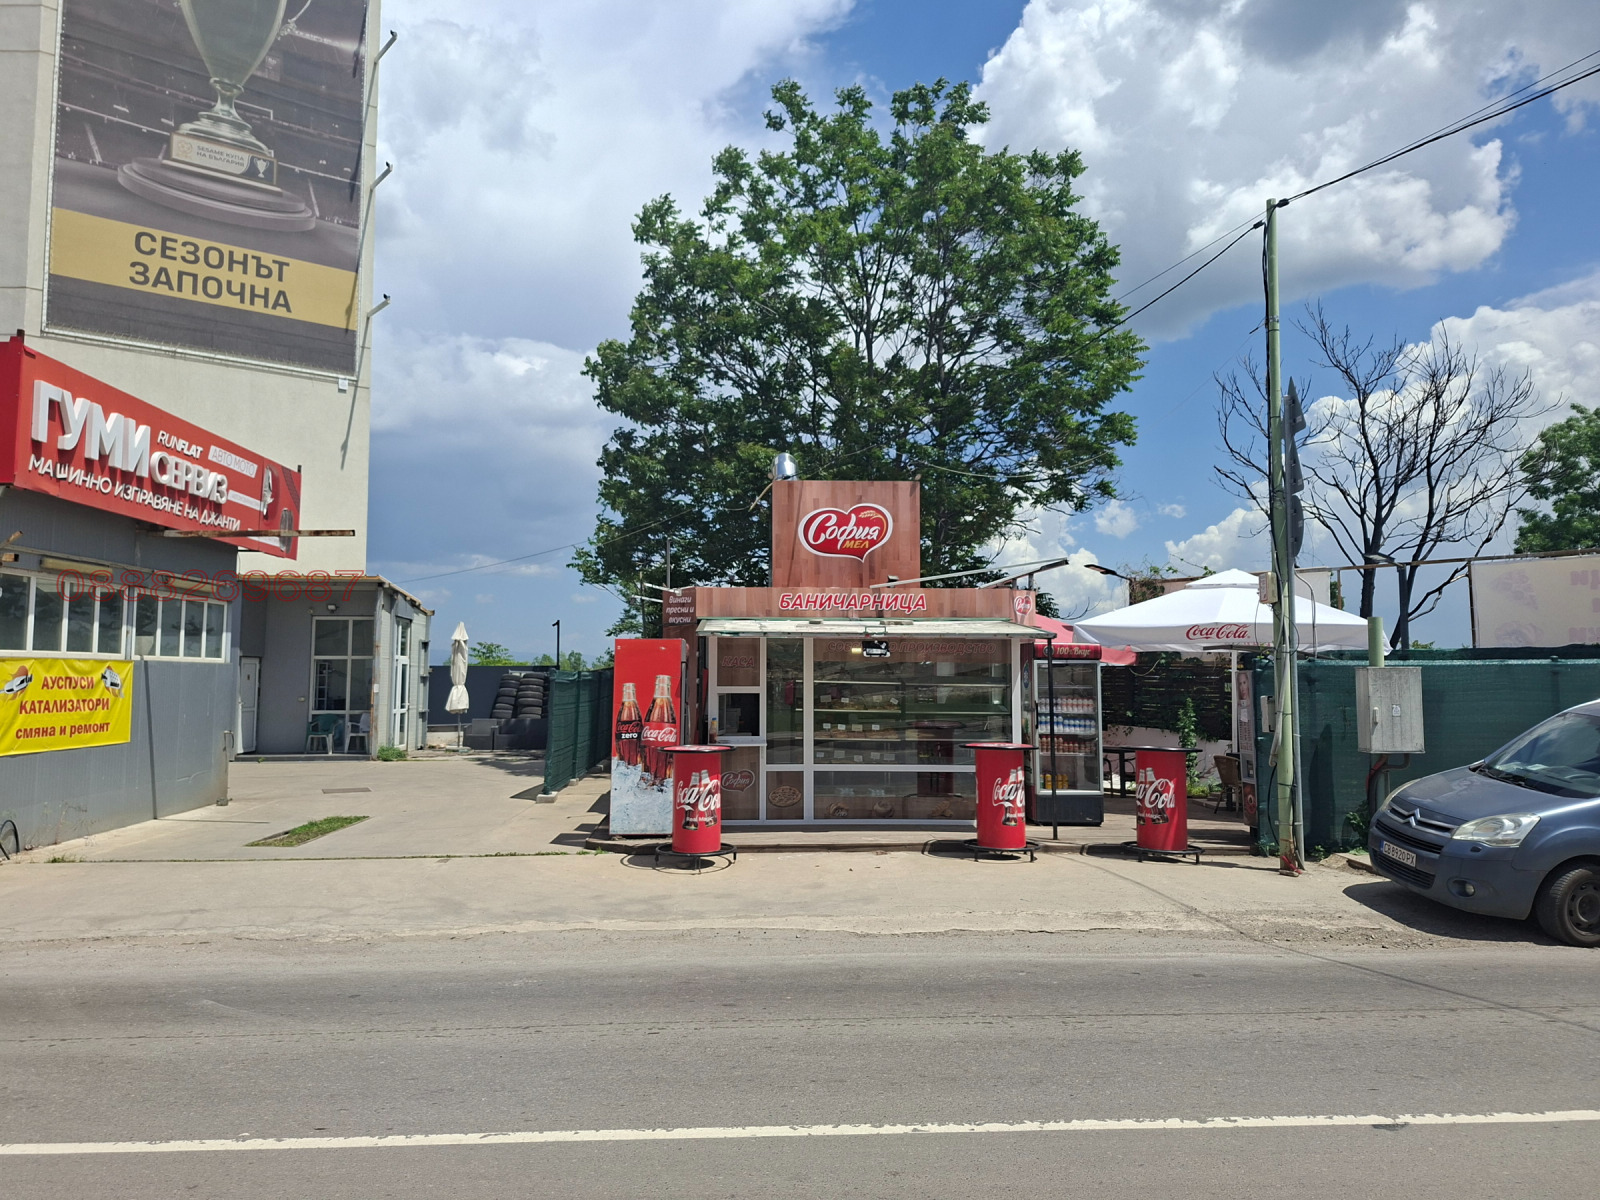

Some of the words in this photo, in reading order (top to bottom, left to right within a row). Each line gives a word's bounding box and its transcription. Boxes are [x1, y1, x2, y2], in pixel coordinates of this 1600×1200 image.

[197, 145, 224, 156] SESAME
[208, 154, 245, 167] БЪЛГАРИЯ
[134, 231, 290, 283] СЕЗОНЪТ
[129, 261, 292, 313] ЗАПОЧНА
[31, 379, 151, 478] ГУМИ
[157, 430, 203, 459] RUNFLAT
[212, 448, 233, 466] АВТО
[233, 457, 255, 476] МОТО
[150, 451, 228, 504] СЕРВИЗ
[114, 479, 183, 518] ИЗПРАВЯНЕ
[184, 501, 199, 520] НА
[200, 506, 240, 531] ДЖАНТИ
[808, 513, 881, 551] София
[843, 539, 870, 549] МЕЛ
[669, 595, 692, 604] Винаги
[778, 592, 927, 614] БАНИЧАРНИЦА
[665, 606, 689, 615] пресни
[1186, 624, 1251, 640] Coca-Cola
[898, 642, 997, 656] ПРОИЗВОДСТВО
[721, 656, 755, 668] КАСА
[41, 675, 95, 691] АУСПУСИ
[19, 698, 110, 715] КАТАЛИЗАТОРИ
[15, 724, 56, 740] смяна
[59, 724, 67, 735] и
[69, 721, 111, 740] ремонт
[641, 726, 677, 742] Coca-Cola
